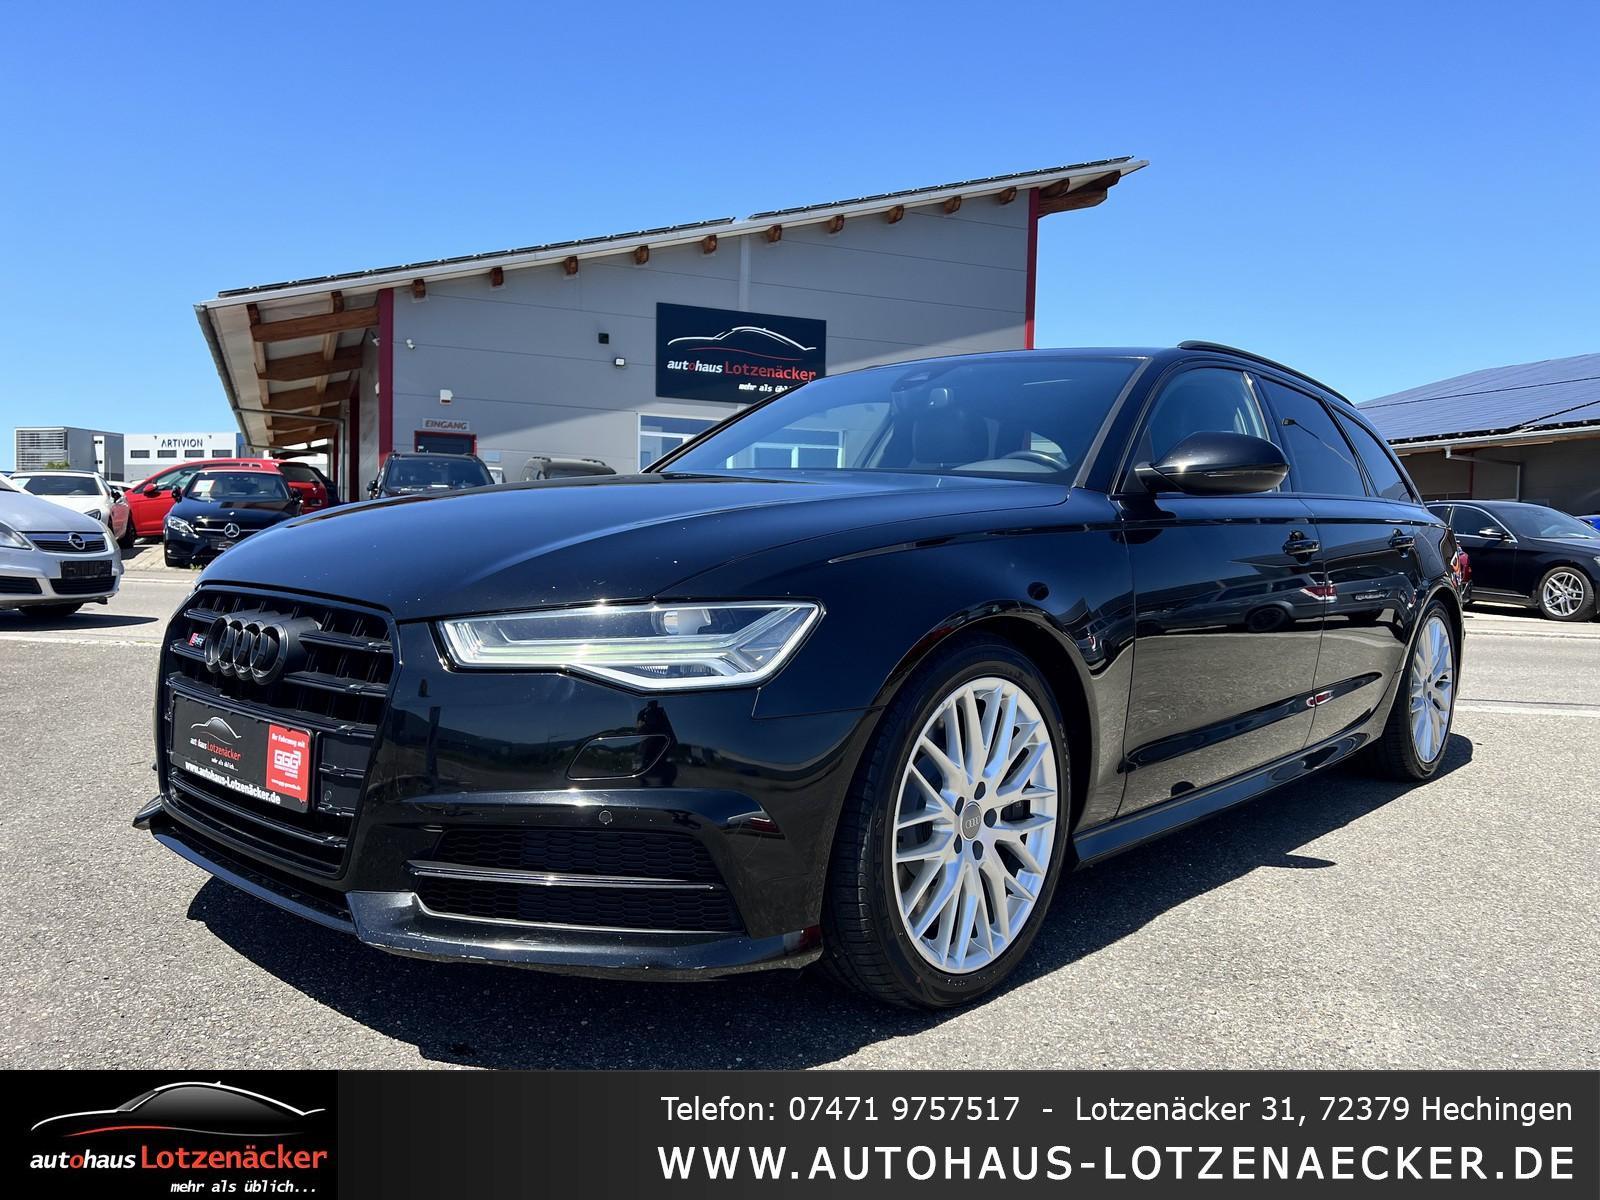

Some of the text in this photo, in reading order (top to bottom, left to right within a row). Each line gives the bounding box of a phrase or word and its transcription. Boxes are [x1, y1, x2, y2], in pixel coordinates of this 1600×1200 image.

[667, 359, 817, 382] autohaus Lotzenäcker
[738, 382, 757, 391] mehr
[759, 383, 773, 393] als
[425, 419, 468, 430] EINGANG
[161, 439, 203, 448] ARTIVION
[190, 737, 241, 760] authaus Lotzenäcker
